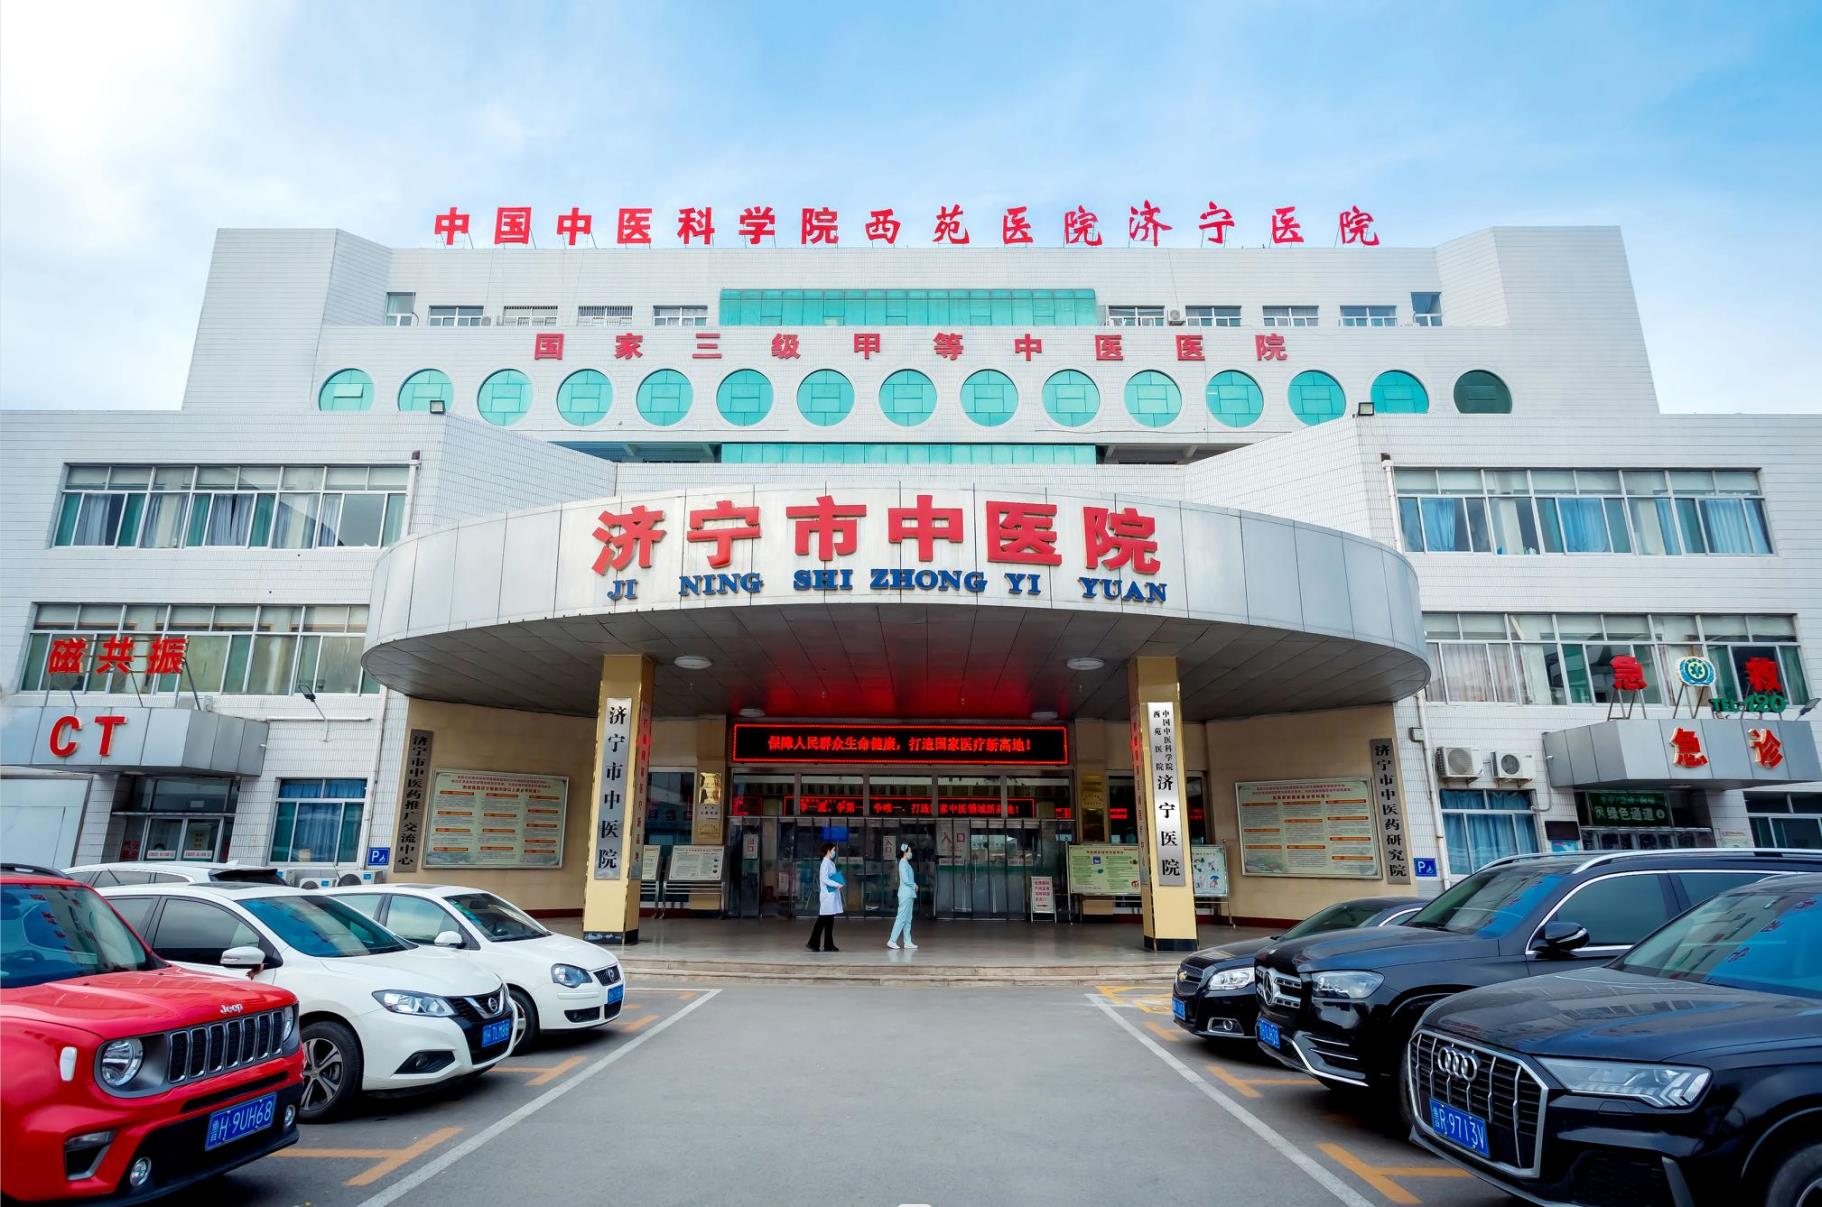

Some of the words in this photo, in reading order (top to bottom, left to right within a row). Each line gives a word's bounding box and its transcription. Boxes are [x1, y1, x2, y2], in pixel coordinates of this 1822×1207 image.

[534, 333, 1288, 361] 国家三级甲等中医医院
[592, 494, 1161, 574] 济宁市中医院
[607, 579, 637, 600] JI
[679, 571, 764, 595] NING
[792, 569, 853, 592] SHI
[870, 568, 988, 592] ZHONG
[1004, 572, 1041, 595] YI
[1080, 577, 1167, 602] YUAN
[48, 635, 190, 674] 磁共振
[49, 715, 128, 757] CT
[1153, 710, 1164, 771] 西苑医院
[1161, 709, 1174, 771] 中国中医科学院
[1670, 727, 1784, 769] 急诊
[397, 734, 430, 866] 济宁市中医药推广交流中心
[598, 705, 627, 870] 济宁市中医院
[1156, 774, 1181, 877] 济宁医院
[1373, 742, 1408, 877] 济宁市中医药研究院
[371, 850, 380, 862] P
[942, 832, 966, 843] 入口
[1417, 861, 1427, 873] P
[220, 1003, 243, 1014] Jeep
